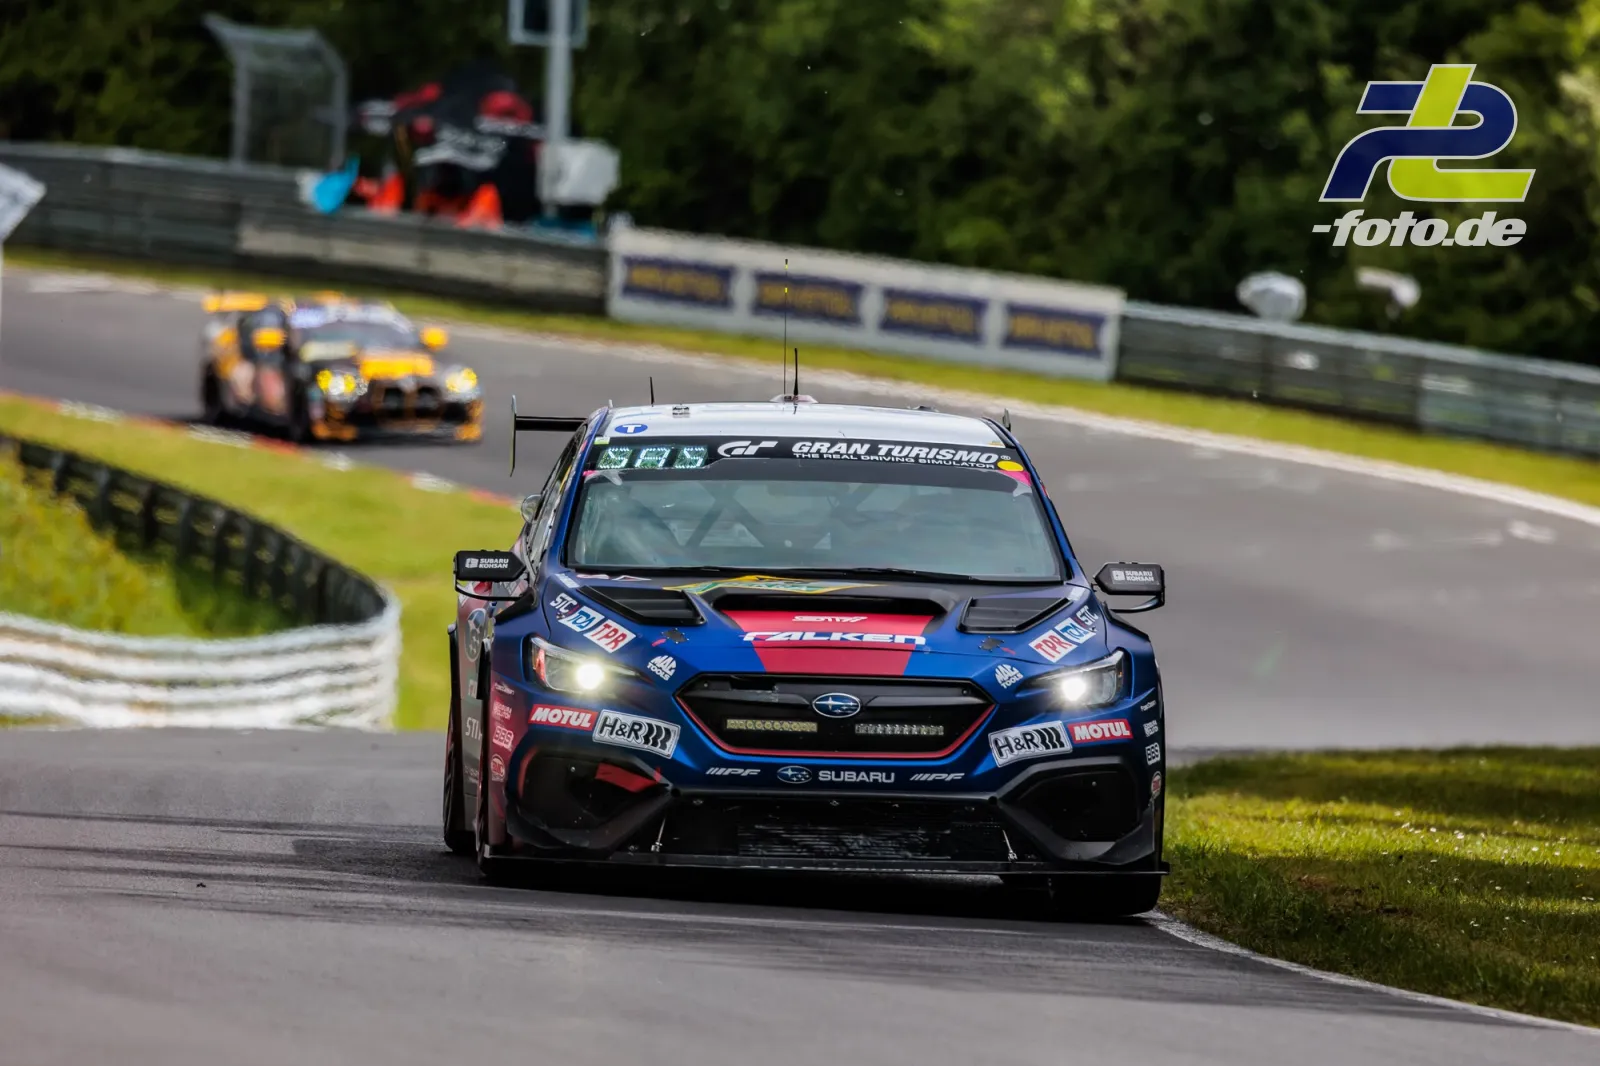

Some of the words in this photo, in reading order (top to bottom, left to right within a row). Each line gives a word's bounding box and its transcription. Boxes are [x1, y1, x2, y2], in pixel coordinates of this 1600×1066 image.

[791, 441, 871, 455] GRAN
[860, 455, 915, 463] DRIVING
[918, 458, 995, 469] SIMULATOR
[591, 623, 628, 650] TPR
[743, 631, 926, 646] FALKEN
[1034, 635, 1073, 659] TPR
[647, 661, 671, 681] TOOLS
[530, 707, 593, 728] MOTUL
[1073, 721, 1131, 741] MOTUL
[818, 770, 895, 783] SUBARU
